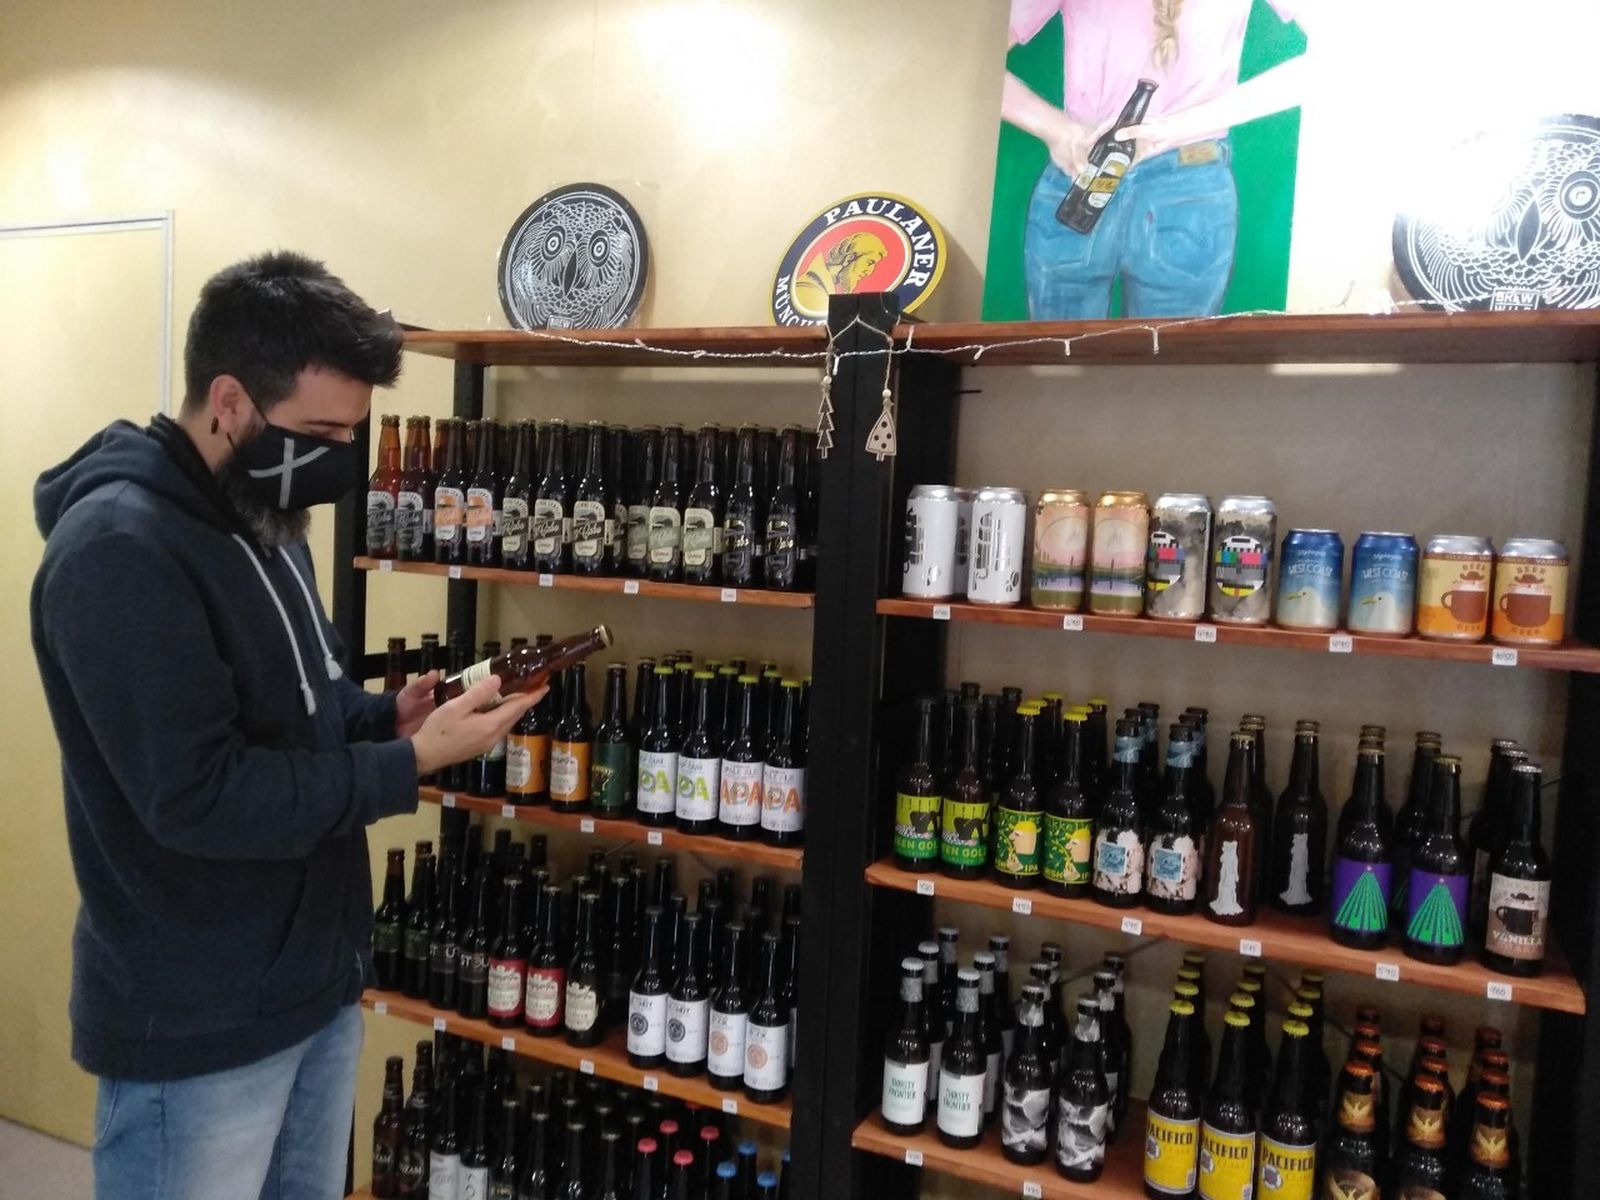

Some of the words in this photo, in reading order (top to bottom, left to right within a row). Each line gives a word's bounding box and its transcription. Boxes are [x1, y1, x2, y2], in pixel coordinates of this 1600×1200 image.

[823, 198, 935, 289] PAULANER
[1496, 291, 1534, 304] BREW
[1288, 564, 1306, 575] WEST
[1306, 563, 1334, 578] COAST
[1363, 568, 1381, 579] WEST
[1517, 566, 1547, 574] BEER
[918, 840, 939, 852] GOL
[1024, 864, 1038, 873] IPA
[1493, 931, 1543, 946] VANILLA
[888, 1087, 917, 1101] FRONTIER
[1262, 1146, 1314, 1172] PACIFICO
